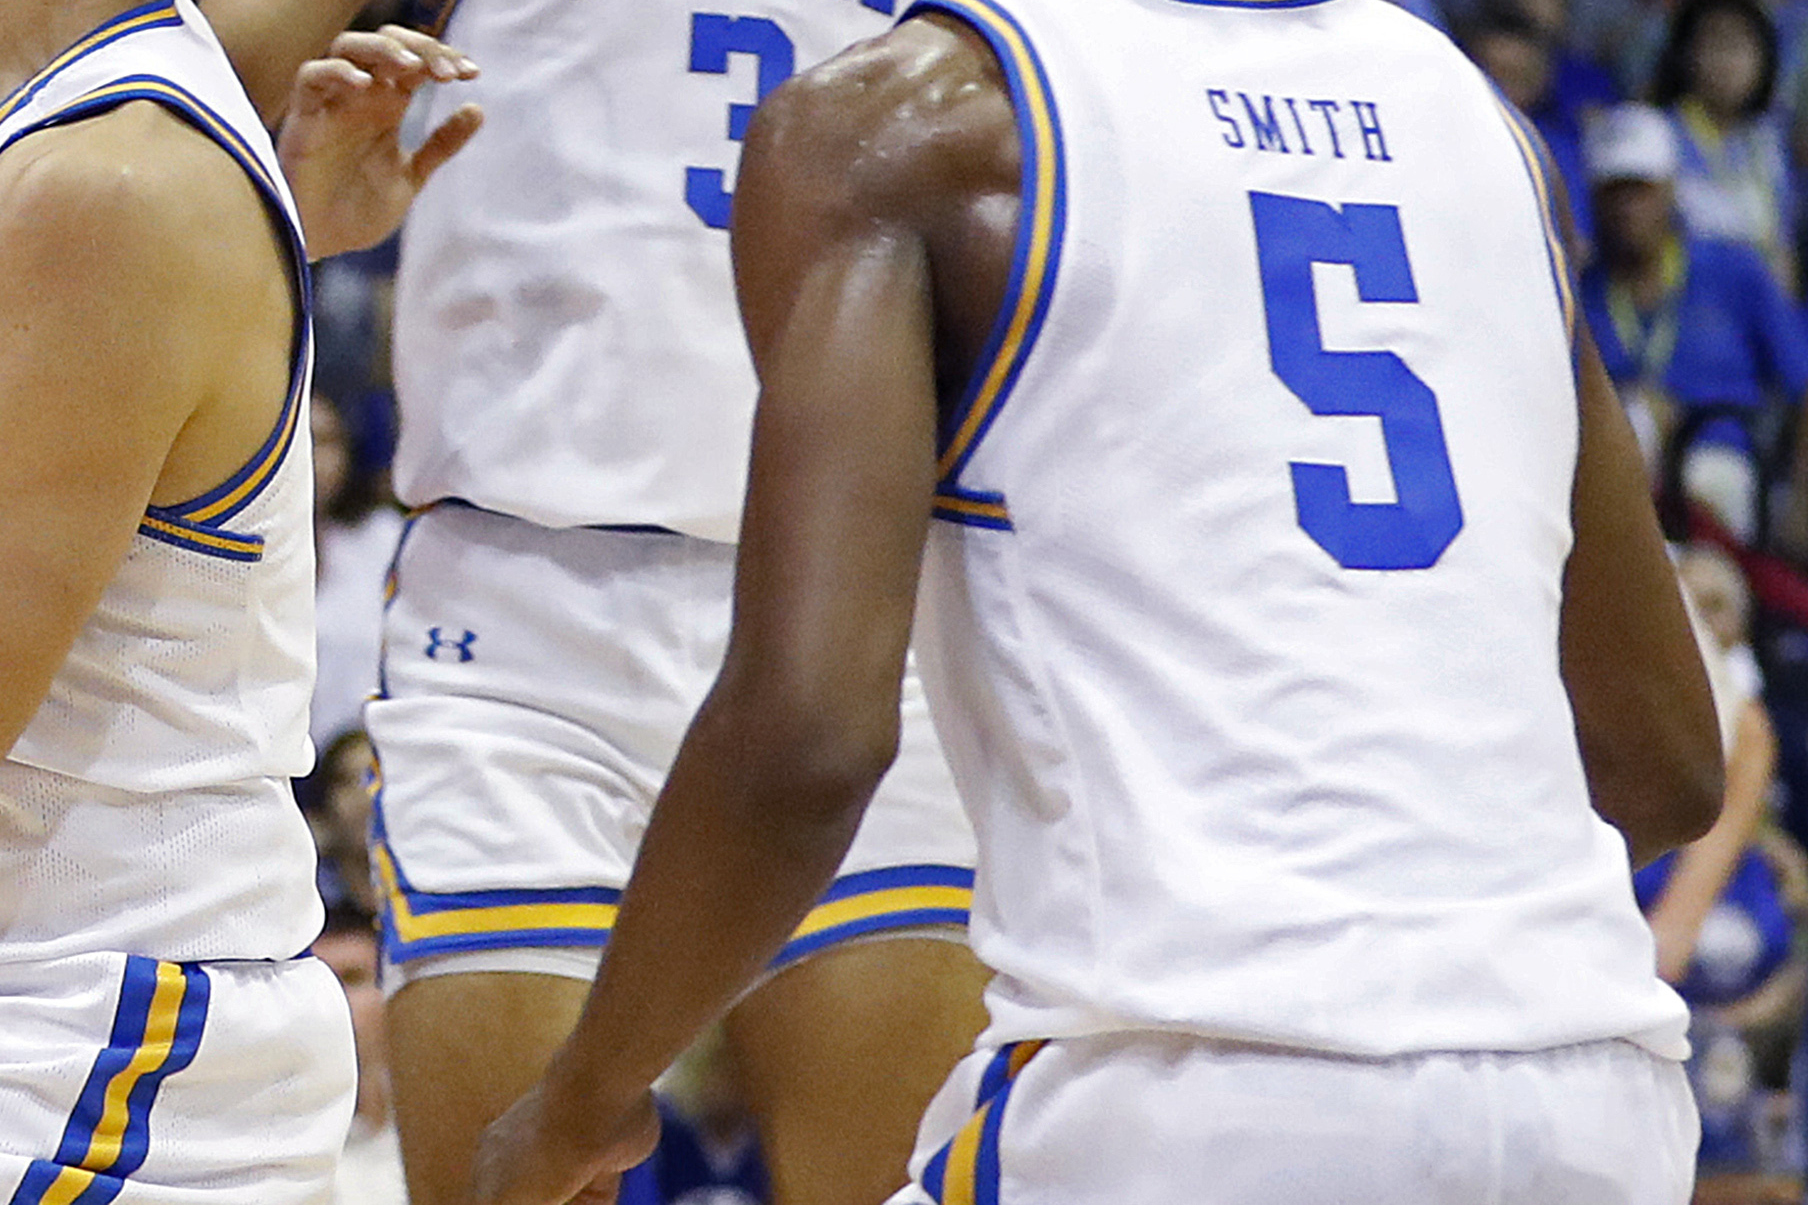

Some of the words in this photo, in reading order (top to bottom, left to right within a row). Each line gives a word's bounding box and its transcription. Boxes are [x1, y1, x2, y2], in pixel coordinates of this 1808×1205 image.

[682, 11, 795, 229] 3
[1206, 89, 1393, 162] SMITH
[1246, 189, 1465, 571] 5
